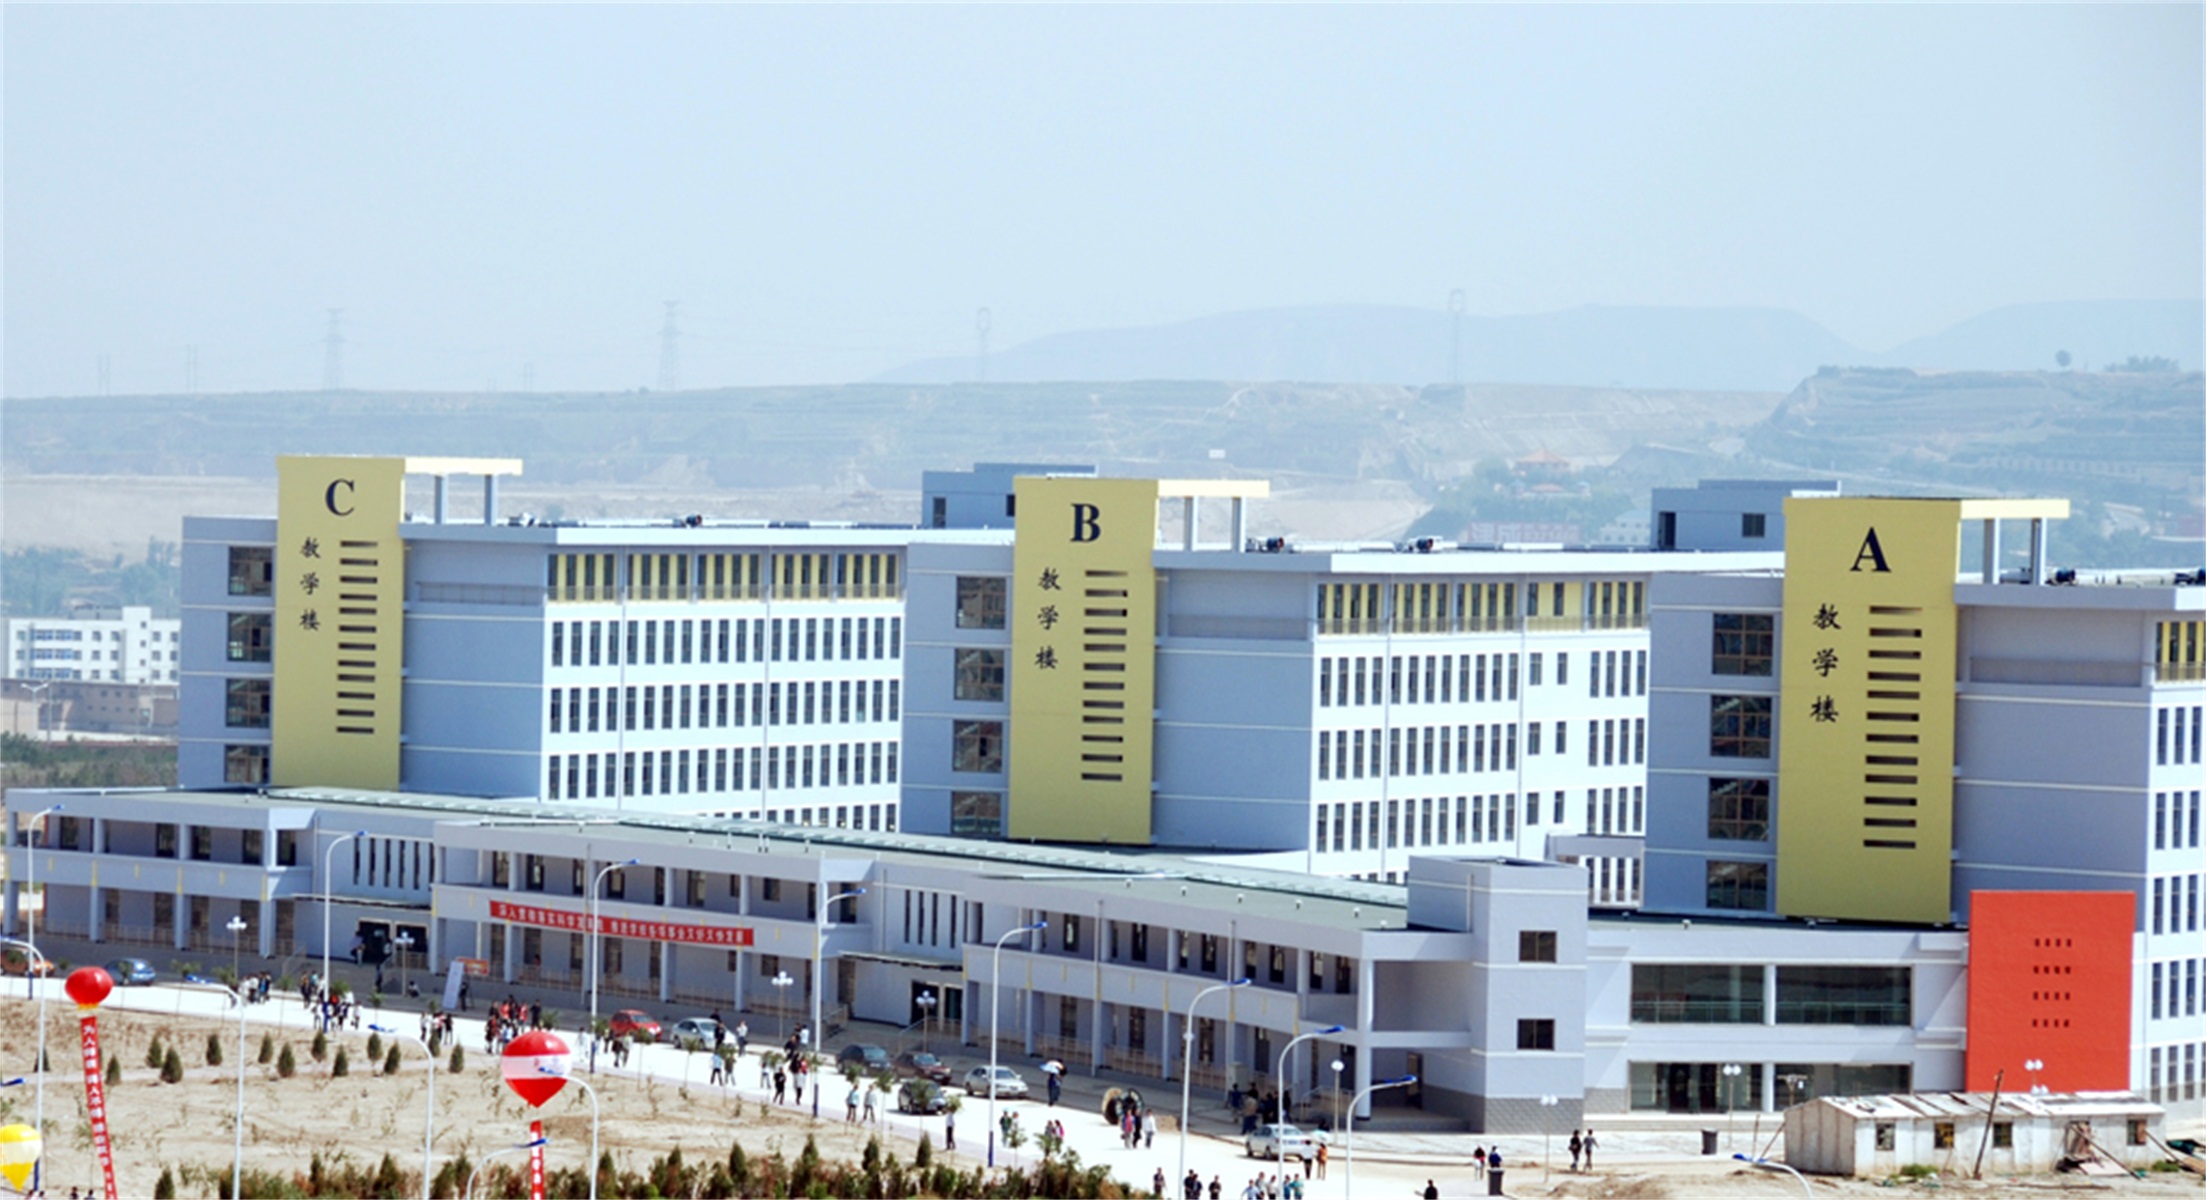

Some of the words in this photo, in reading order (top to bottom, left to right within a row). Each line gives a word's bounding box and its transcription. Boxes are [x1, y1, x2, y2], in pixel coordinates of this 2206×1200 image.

[326, 479, 355, 516] C
[1070, 503, 1101, 542] B
[300, 537, 320, 631] 教学楼
[1850, 526, 1891, 572] A
[1035, 568, 1061, 669] 教学楼
[1810, 604, 1842, 722] 教学楼
